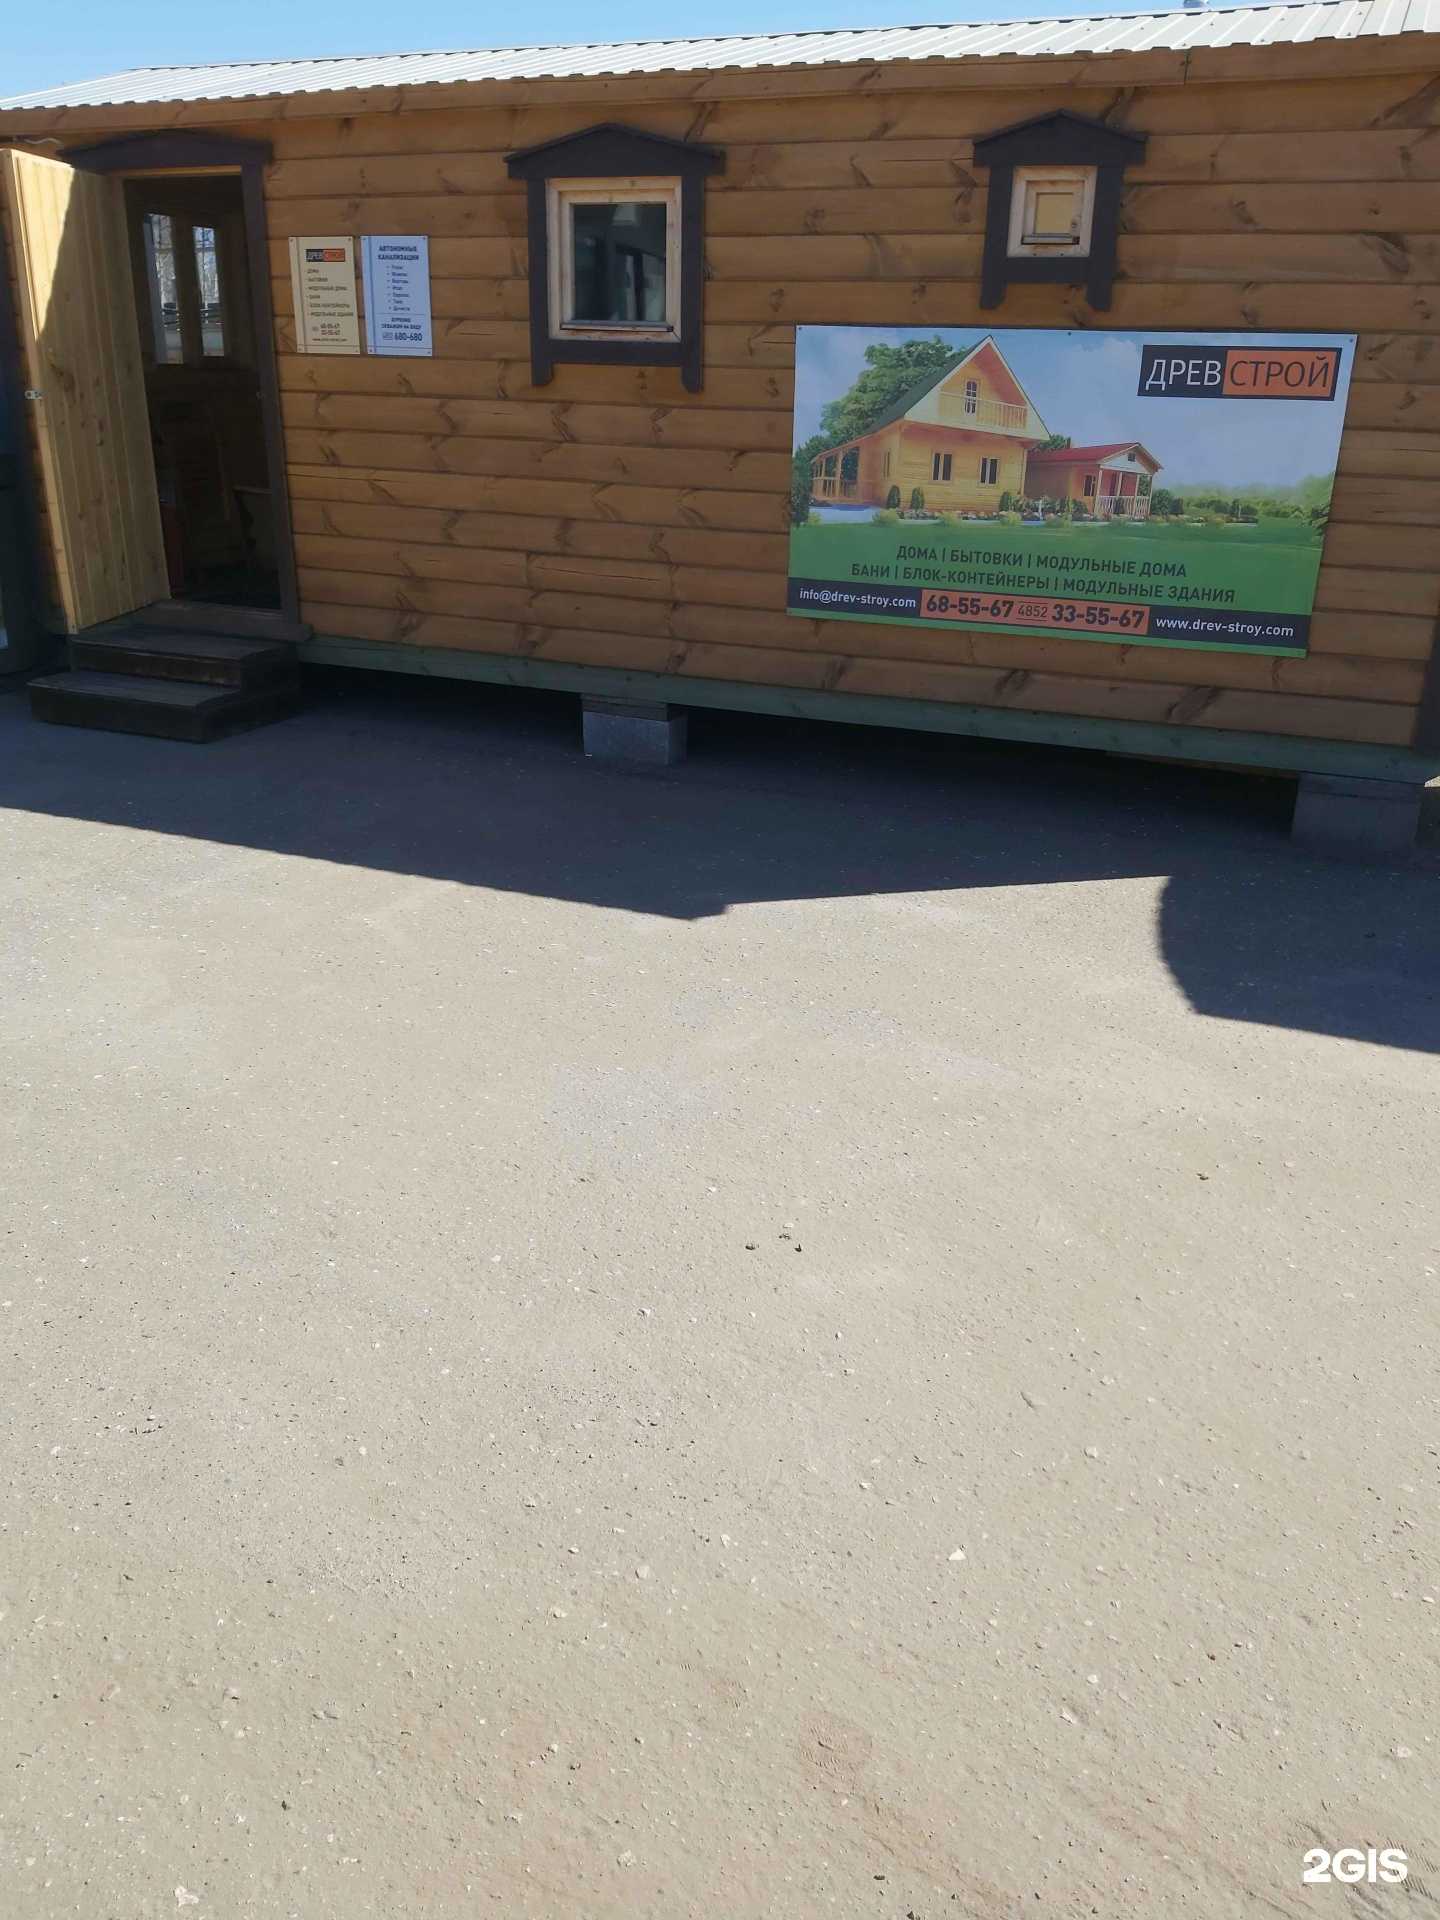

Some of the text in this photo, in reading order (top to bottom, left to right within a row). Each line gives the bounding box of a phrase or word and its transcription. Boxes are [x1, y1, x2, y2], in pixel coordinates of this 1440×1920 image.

[896, 545, 1187, 578] ДОМА БЫТОВКИ МОДУЛЬНЫЕ ДОМА
[799, 587, 916, 608] info@drev-stroy.com
[852, 563, 1235, 602] БАНИ БЛОК-КОНТЕЙНЕРЫ МОДУЛЬНЫЕ ЗДАНИЯ
[926, 594, 1145, 629] 68-55-67 4852 33-55-67
[1156, 616, 1294, 637] www.drev-stroy.com
